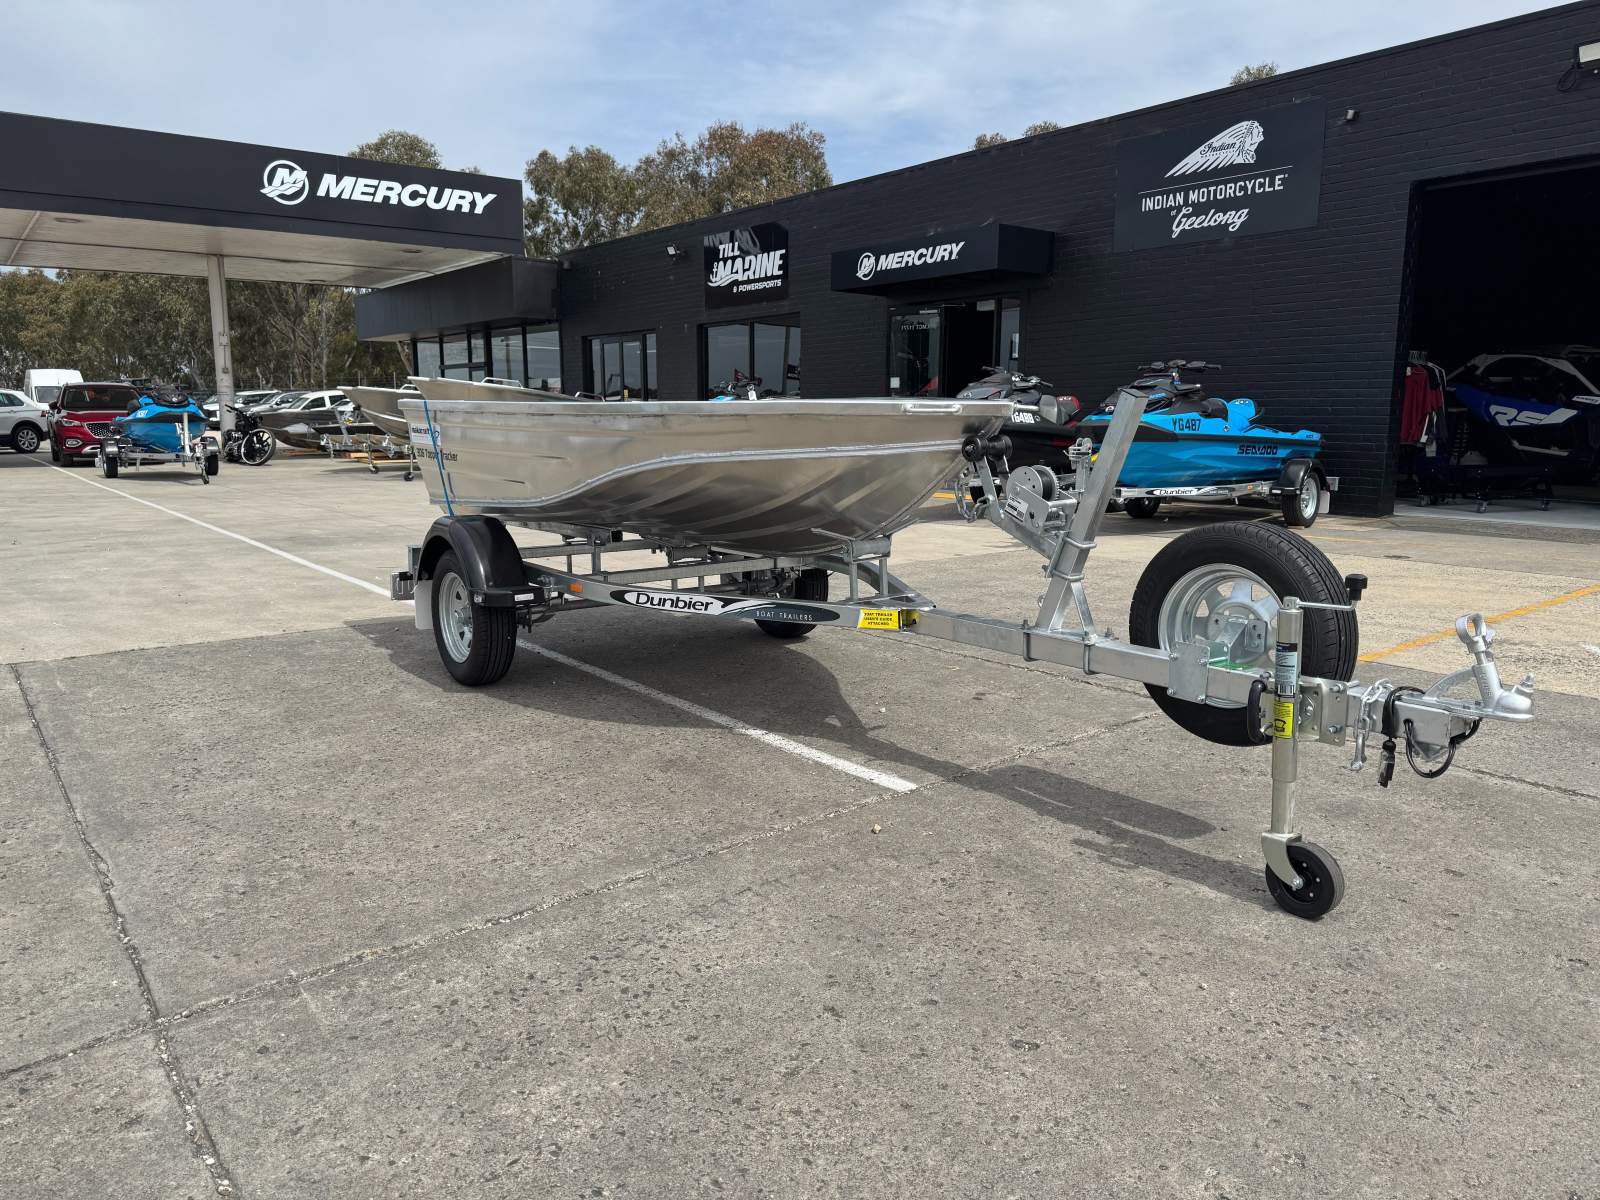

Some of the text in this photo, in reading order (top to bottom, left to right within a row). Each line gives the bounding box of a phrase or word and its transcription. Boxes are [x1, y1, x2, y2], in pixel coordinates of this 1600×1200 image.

[316, 173, 498, 215] MERCURY
[1141, 174, 1285, 212] INDIAN MOTORCYCLE
[1171, 206, 1250, 239] Geelong
[718, 241, 741, 259] TILL
[876, 241, 966, 271] MERCURY
[716, 249, 786, 282] MARINE
[738, 279, 782, 293] POWERSPORTS
[1171, 417, 1201, 432] YG487
[635, 591, 813, 621] Dunbier BOAT TRAILERS
